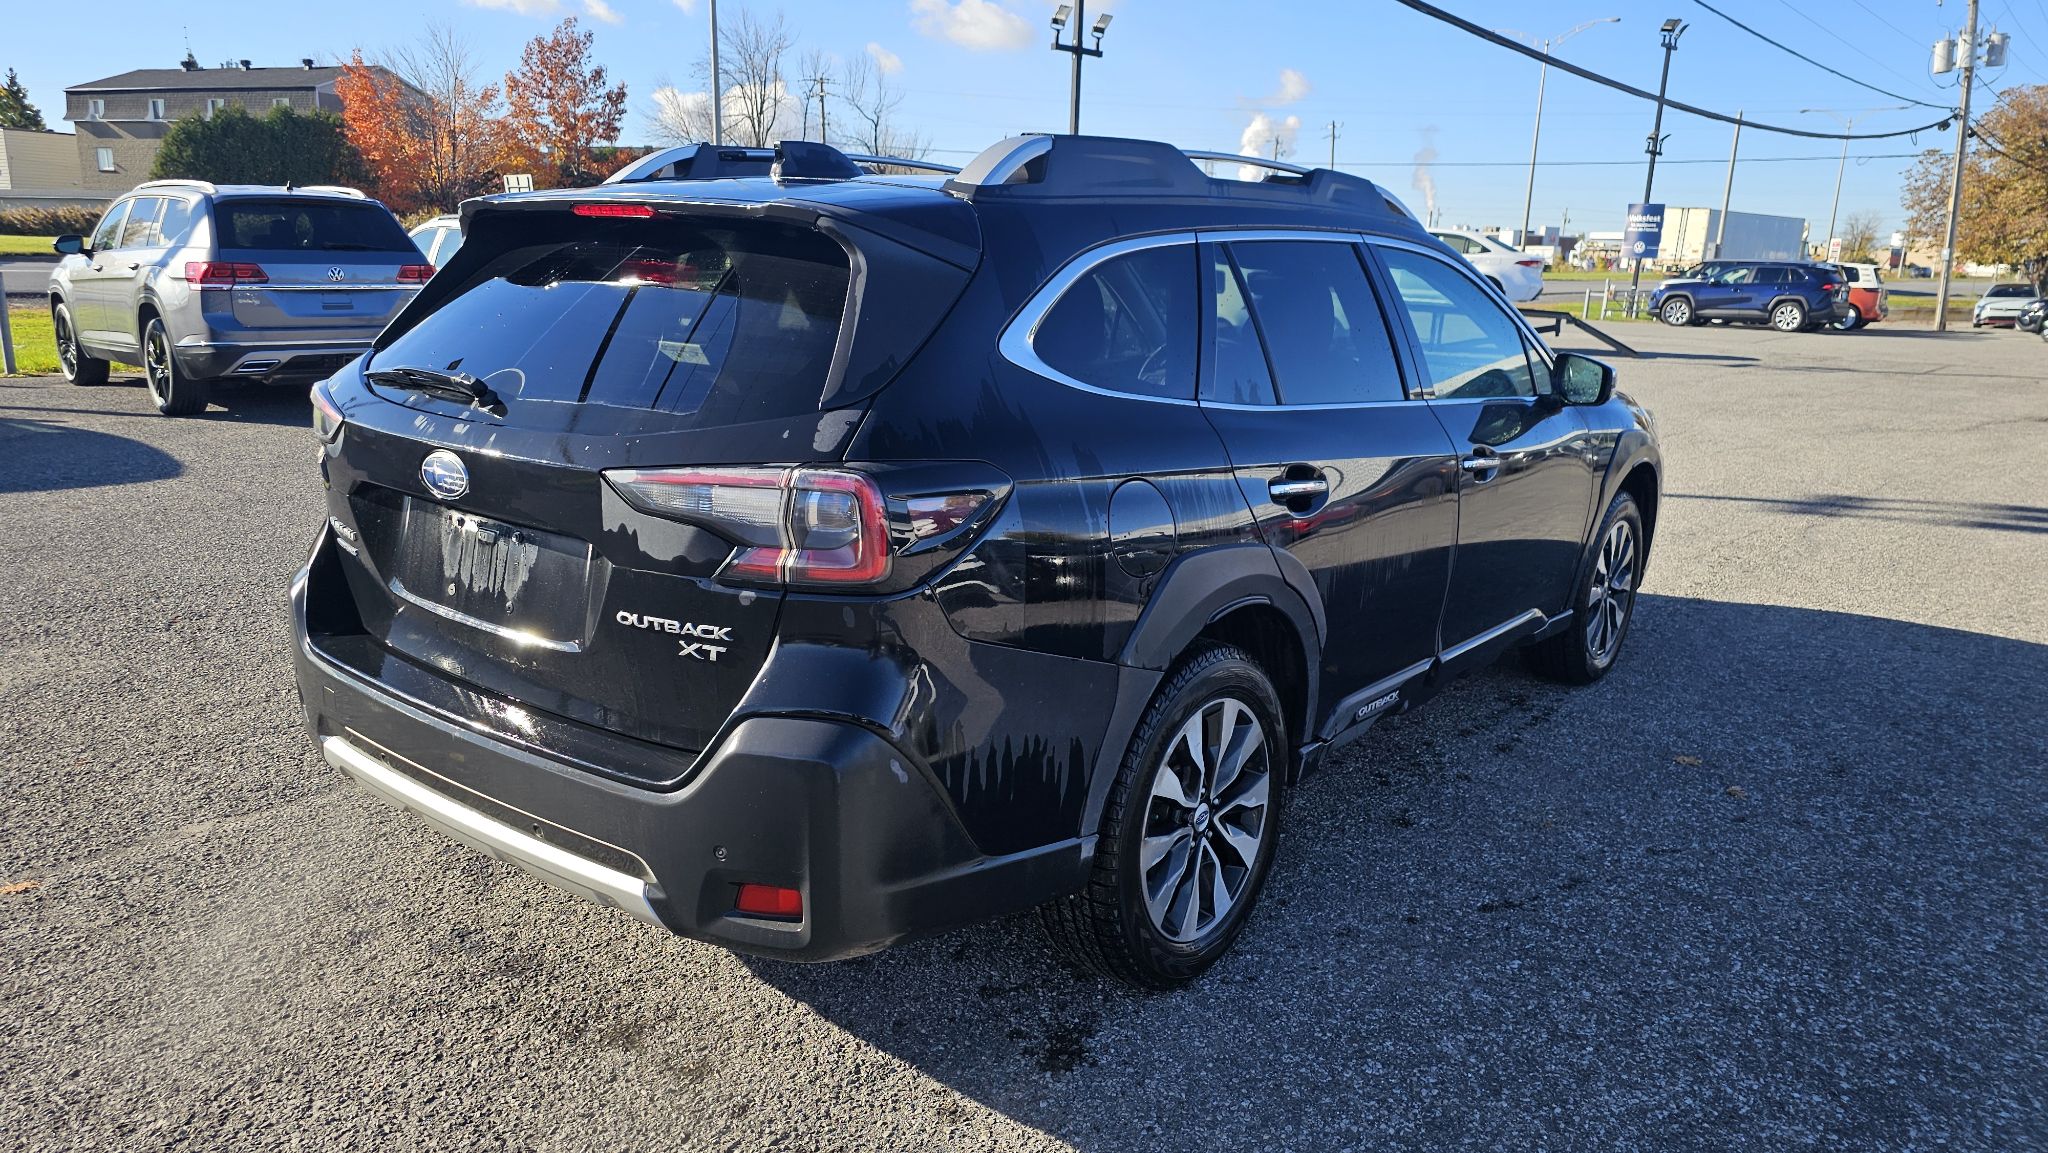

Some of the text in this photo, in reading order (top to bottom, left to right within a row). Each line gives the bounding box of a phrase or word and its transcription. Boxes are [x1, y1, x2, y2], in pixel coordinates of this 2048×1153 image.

[616, 610, 734, 642] OUTBACK
[678, 640, 728, 662] XT
[1358, 690, 1400, 717] OUTBACK
